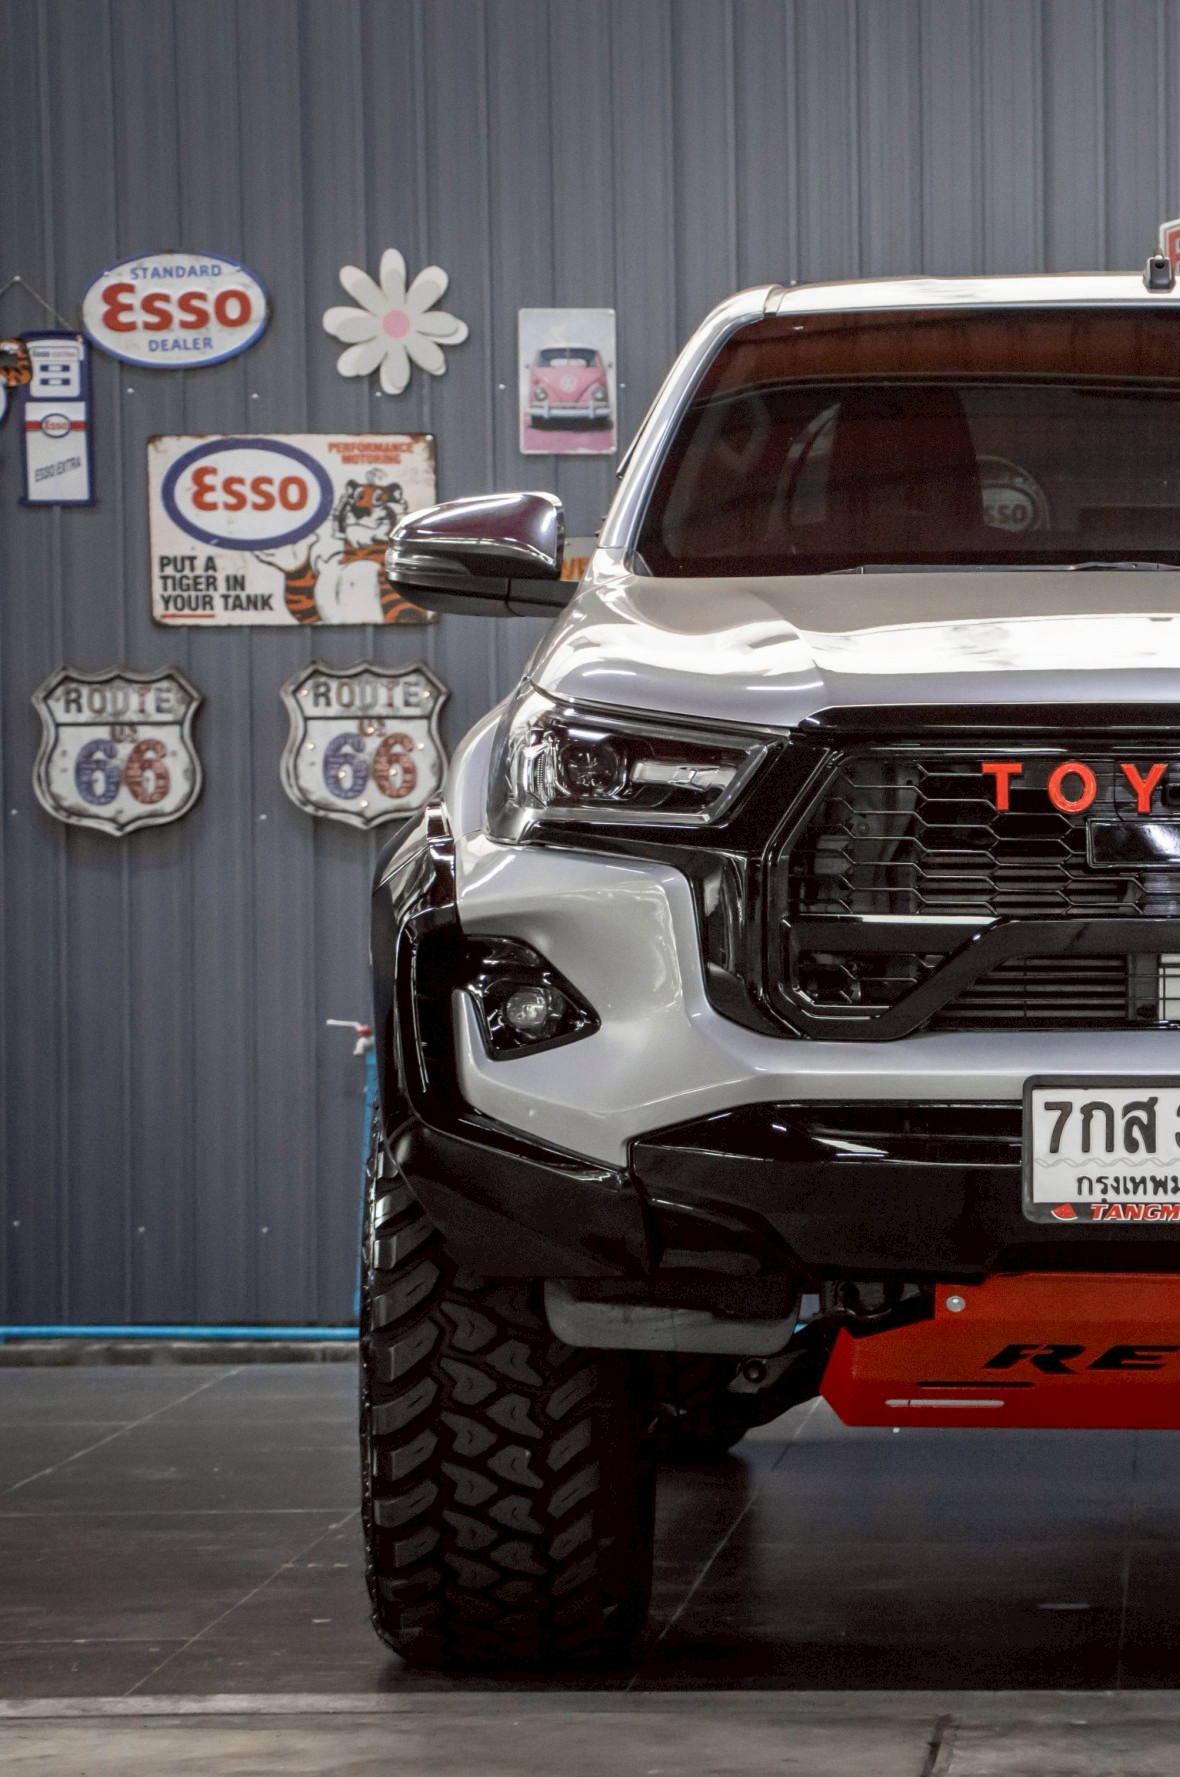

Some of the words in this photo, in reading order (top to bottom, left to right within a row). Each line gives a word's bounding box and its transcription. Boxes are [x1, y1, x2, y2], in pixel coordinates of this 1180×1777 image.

[130, 264, 222, 280] STANDARD
[148, 337, 213, 352] DEALER
[159, 555, 197, 573] PUT
[204, 555, 217, 573] A
[159, 574, 217, 592] TIGER
[225, 574, 246, 592] IN
[160, 593, 214, 612] YOUR
[220, 593, 275, 611] TANK
[63, 685, 173, 716] ROUTE
[313, 679, 421, 712] ROUTE
[74, 738, 171, 806] 66
[322, 732, 417, 800] 66
[1043, 1096, 1160, 1154] 7กส
